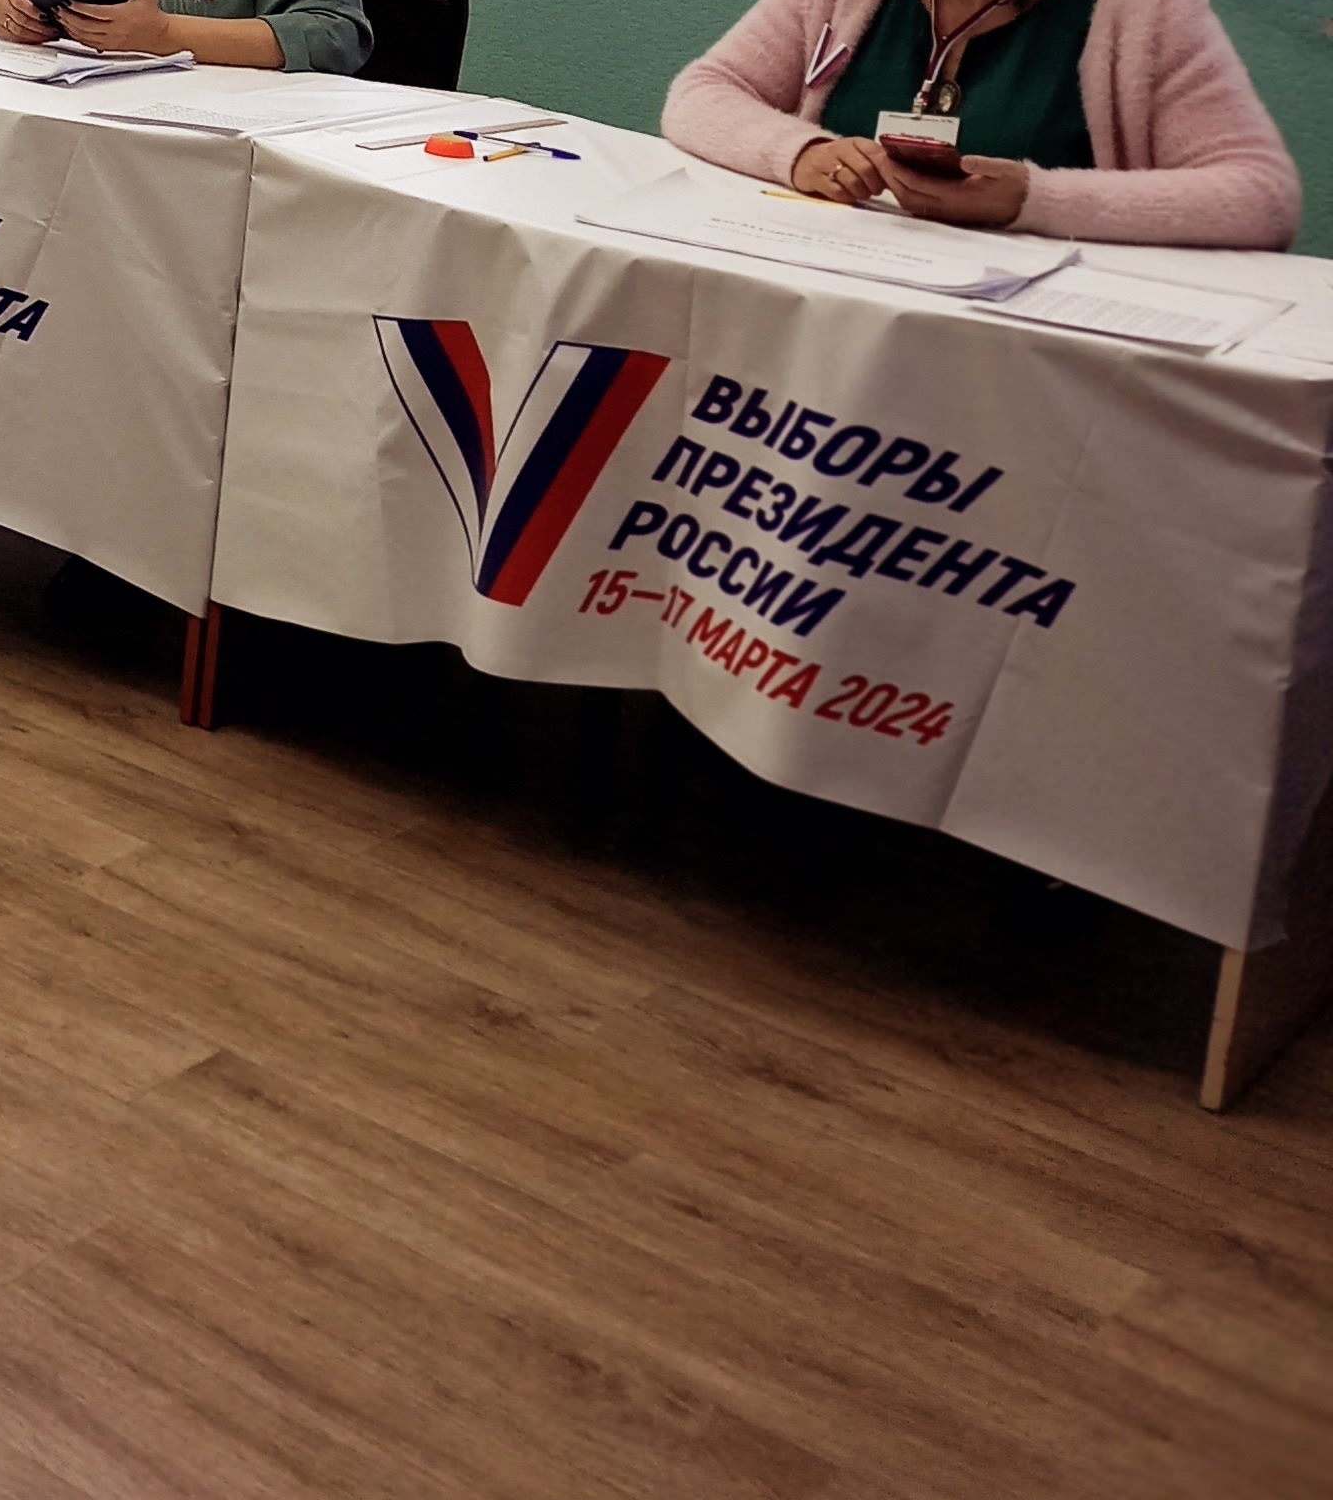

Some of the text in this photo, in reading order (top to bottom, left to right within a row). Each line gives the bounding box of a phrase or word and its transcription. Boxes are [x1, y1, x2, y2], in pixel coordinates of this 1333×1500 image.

[690, 374, 1004, 513] ВЫБОРЫ
[607, 500, 847, 637] РОССИИ
[651, 435, 1077, 629] ПРЕЗИДЕНТА
[686, 606, 823, 709] МАРТА
[813, 674, 955, 746] 2024
